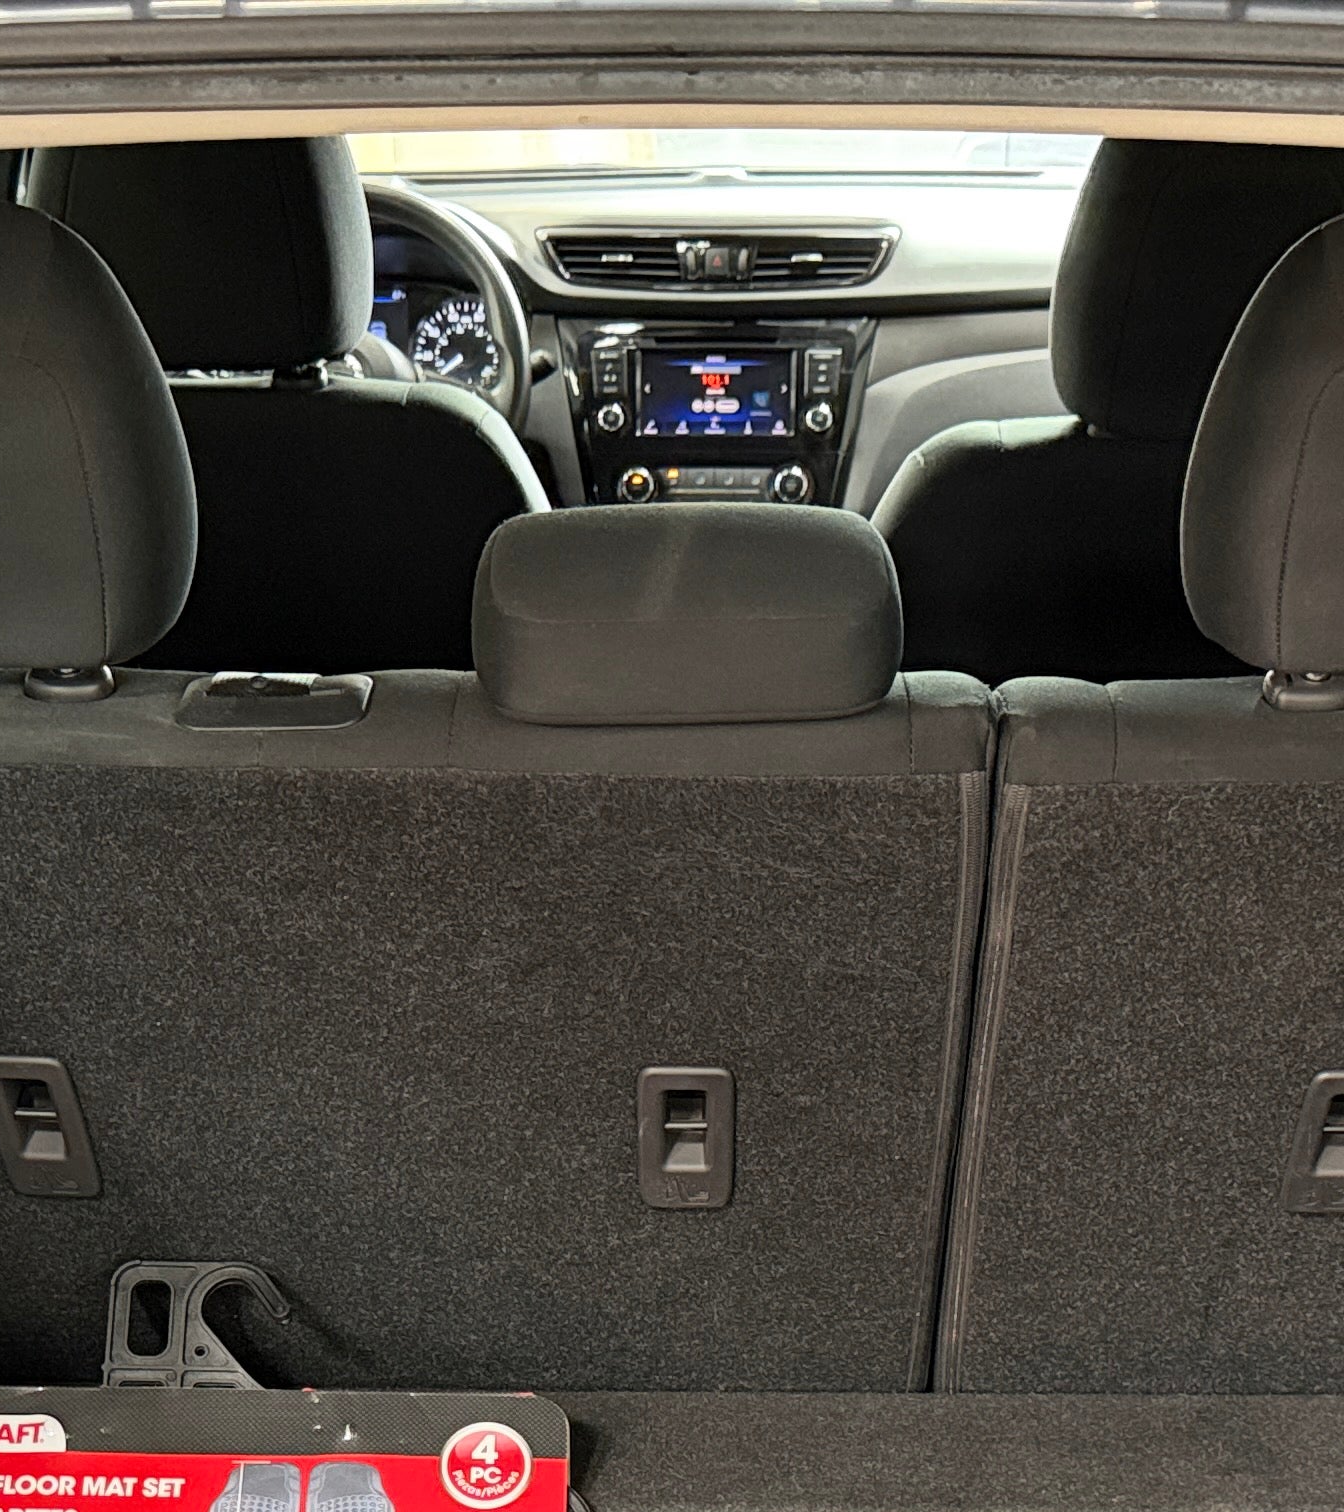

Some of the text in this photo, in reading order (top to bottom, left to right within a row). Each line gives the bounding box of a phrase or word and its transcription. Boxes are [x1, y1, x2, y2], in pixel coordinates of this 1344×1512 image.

[471, 1434, 499, 1465] 4
[469, 1466, 503, 1484] PC
[82, 1476, 138, 1498] MAT
[142, 1477, 186, 1498] SET
